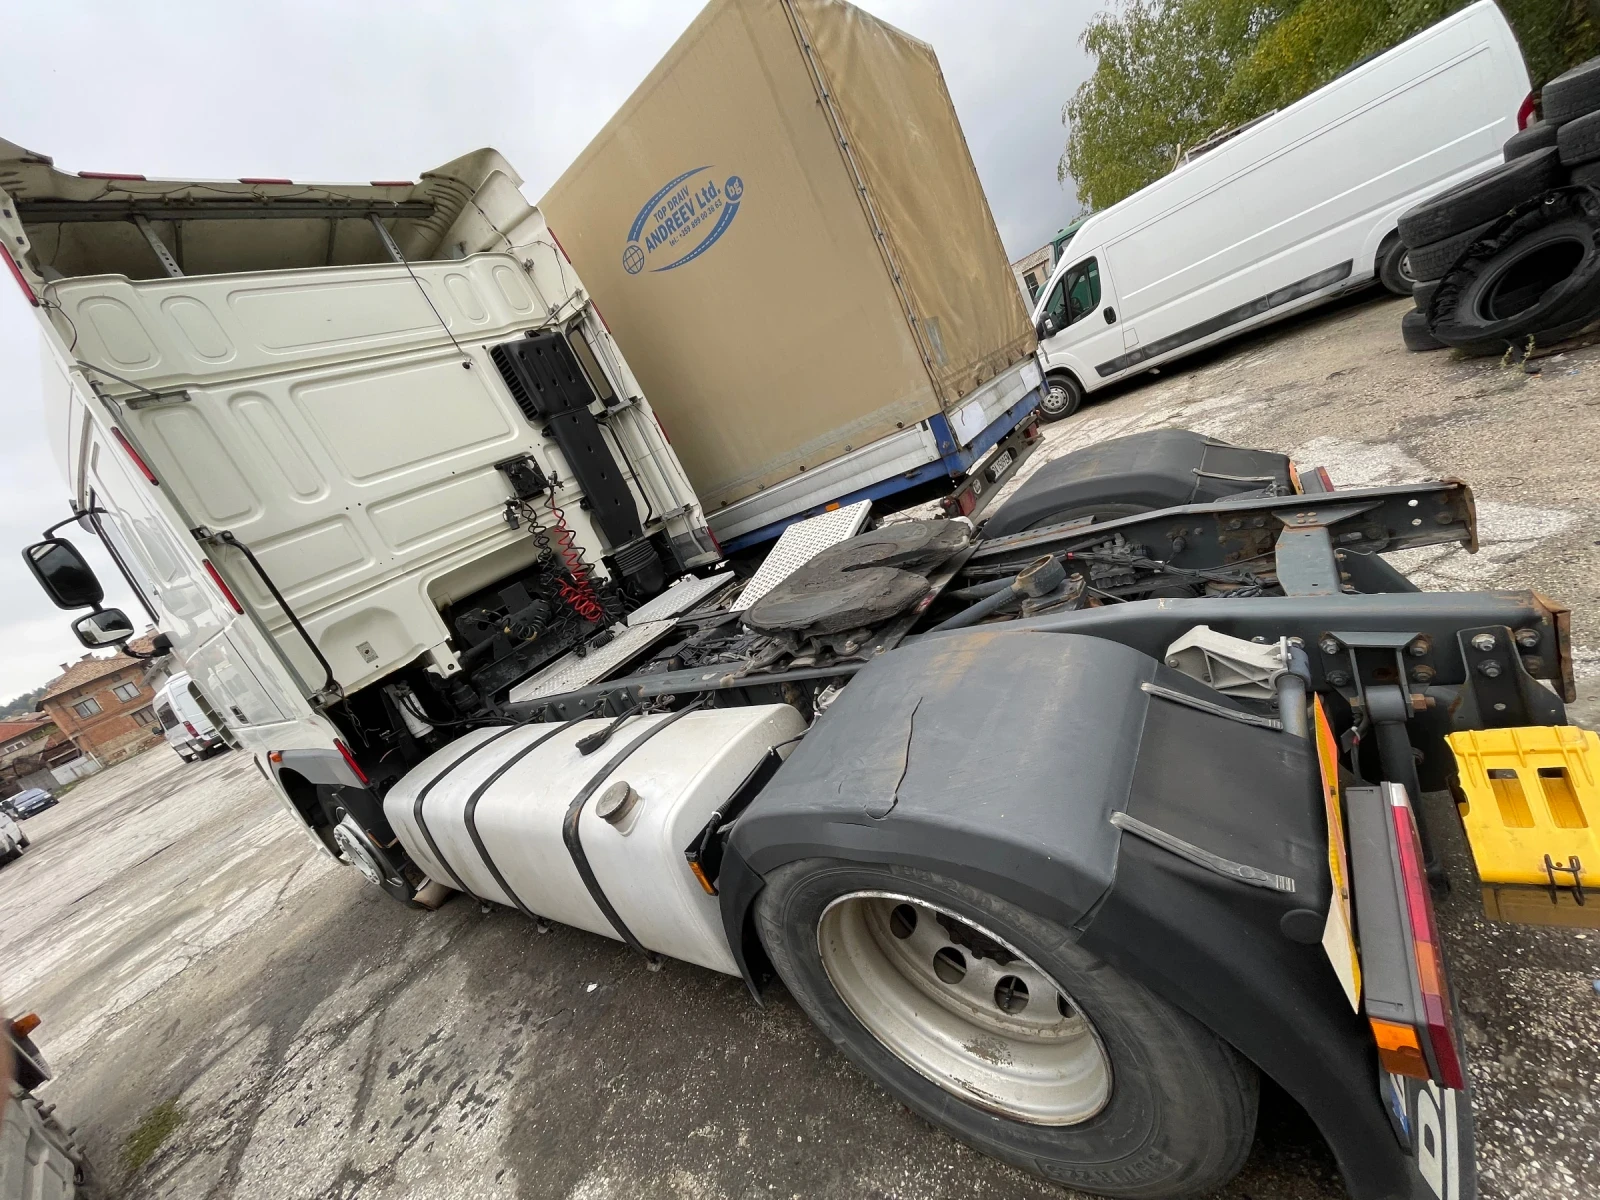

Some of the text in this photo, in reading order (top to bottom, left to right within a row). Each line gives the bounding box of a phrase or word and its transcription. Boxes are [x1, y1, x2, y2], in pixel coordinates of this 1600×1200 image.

[727, 178, 742, 198] bg
[644, 180, 722, 254] ANDREEV Ltd.
[653, 185, 690, 223] TOP DRAIV
[679, 225, 691, 238] +359
[691, 216, 701, 229] 899
